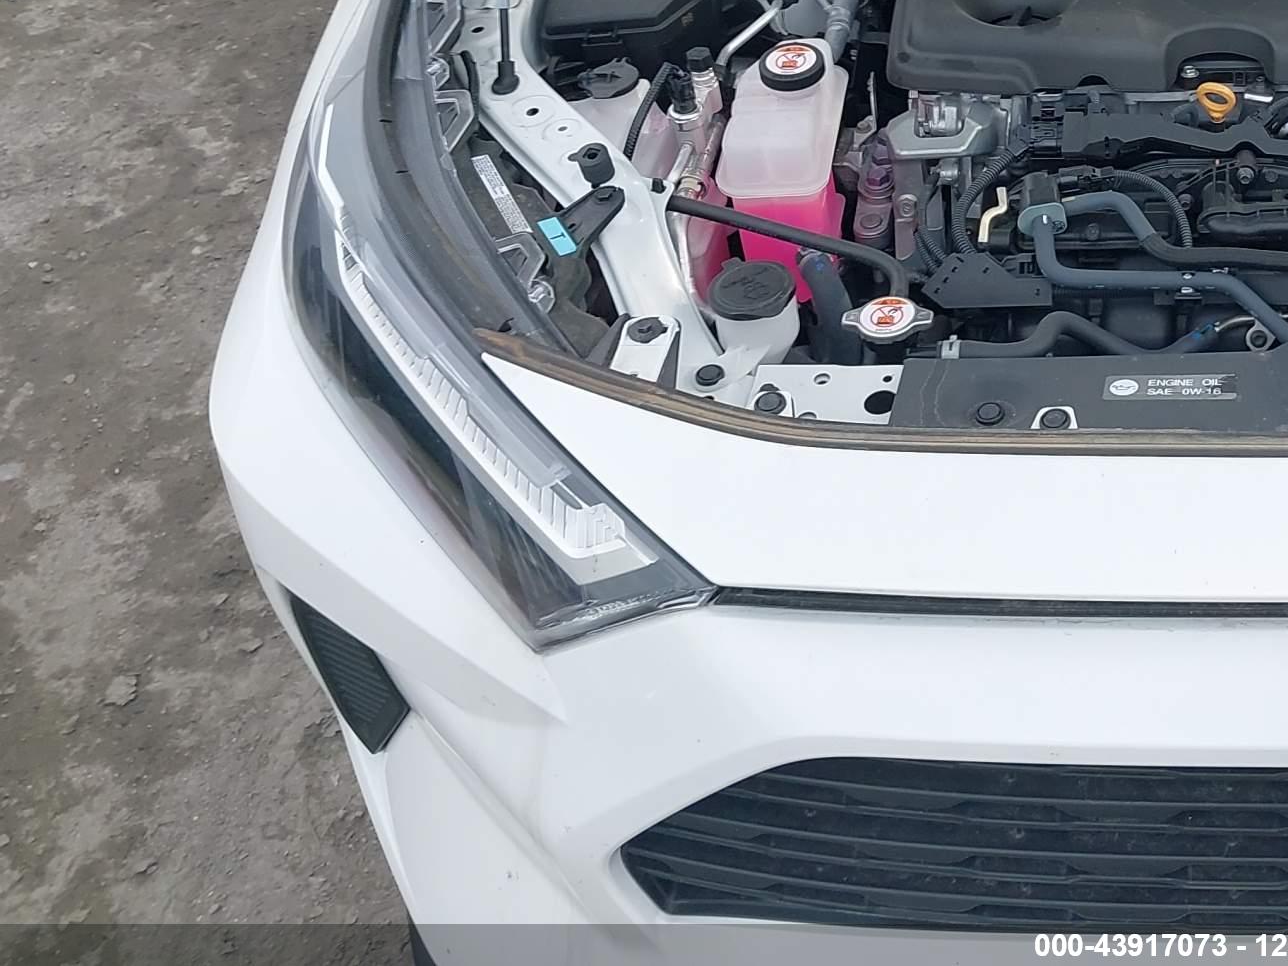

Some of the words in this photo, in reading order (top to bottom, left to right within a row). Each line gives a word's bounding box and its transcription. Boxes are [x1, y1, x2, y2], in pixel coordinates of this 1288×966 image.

[1147, 378, 1194, 387] ENGINE
[1201, 378, 1223, 386] OIL
[1146, 387, 1174, 396] SAE
[1182, 387, 1222, 396] 0W-16
